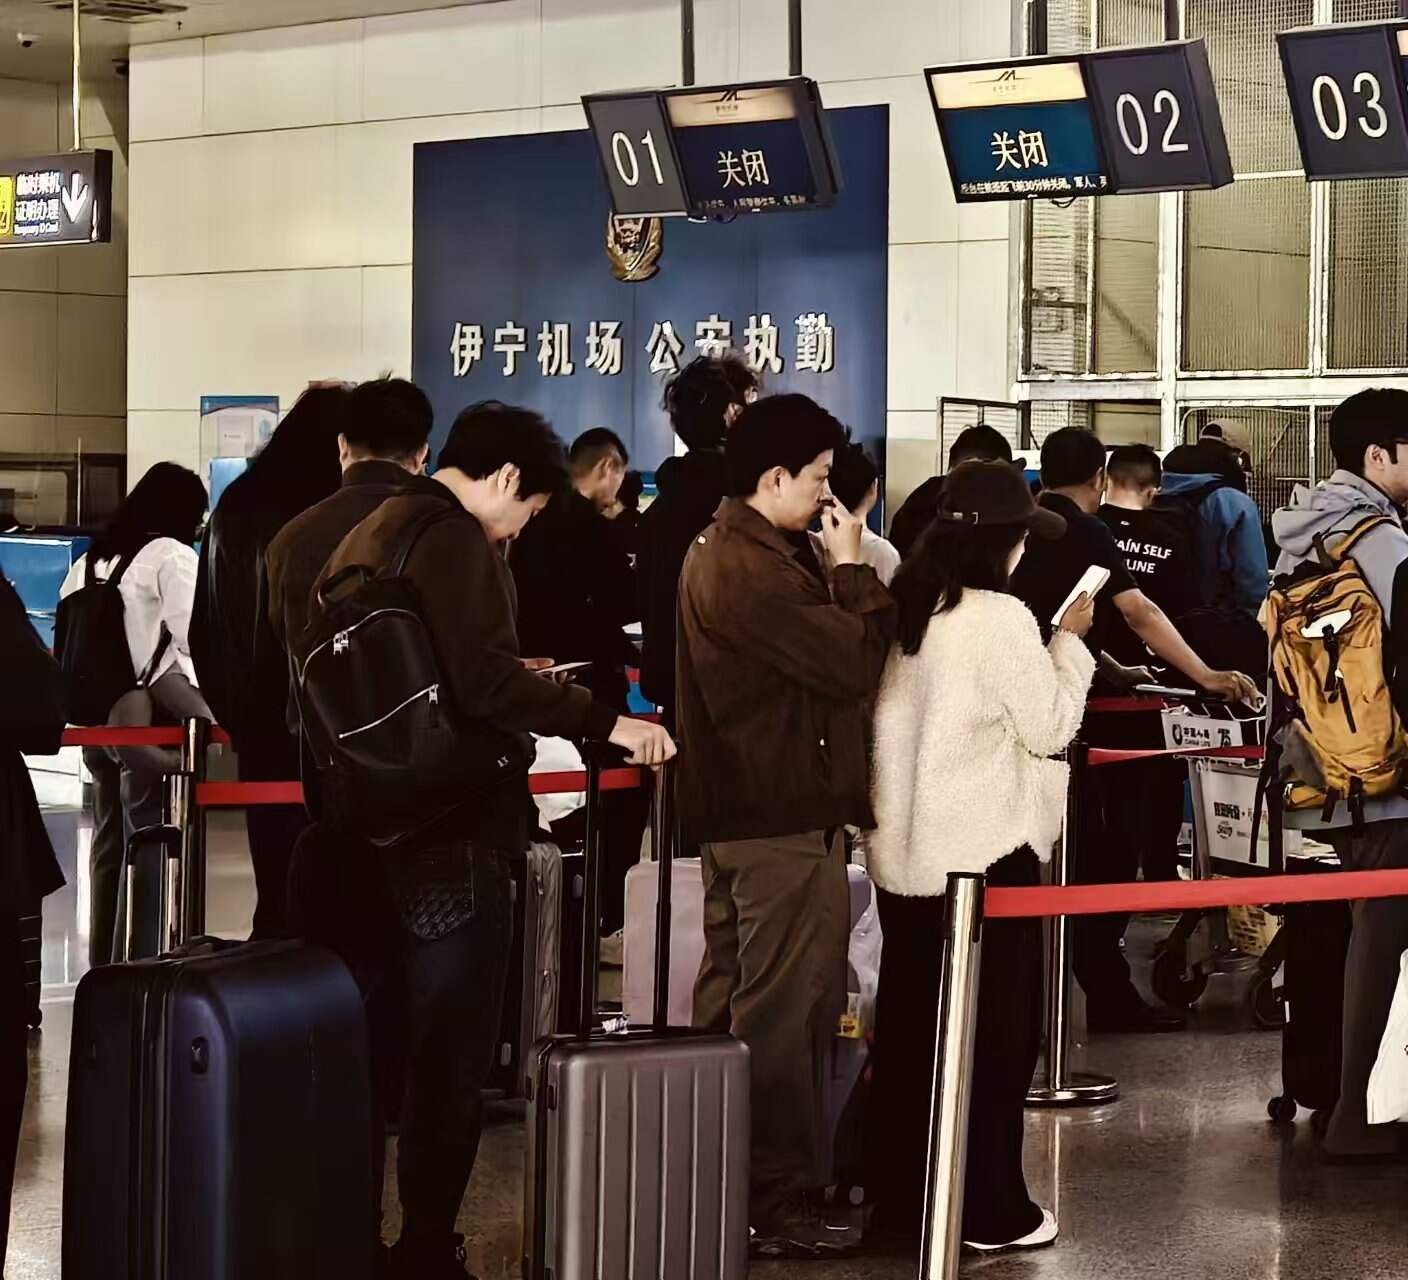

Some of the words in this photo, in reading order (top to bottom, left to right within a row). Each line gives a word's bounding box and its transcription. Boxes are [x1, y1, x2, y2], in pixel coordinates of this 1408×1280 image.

[1116, 89, 1189, 156] 02
[1311, 72, 1388, 141] 03
[611, 128, 664, 186] 01
[717, 149, 770, 188] 关闭
[991, 129, 1049, 171] 关闭
[449, 320, 626, 377] 伊宁机场
[645, 312, 837, 375] 公安执勤
[1142, 544, 1172, 559] SELF
